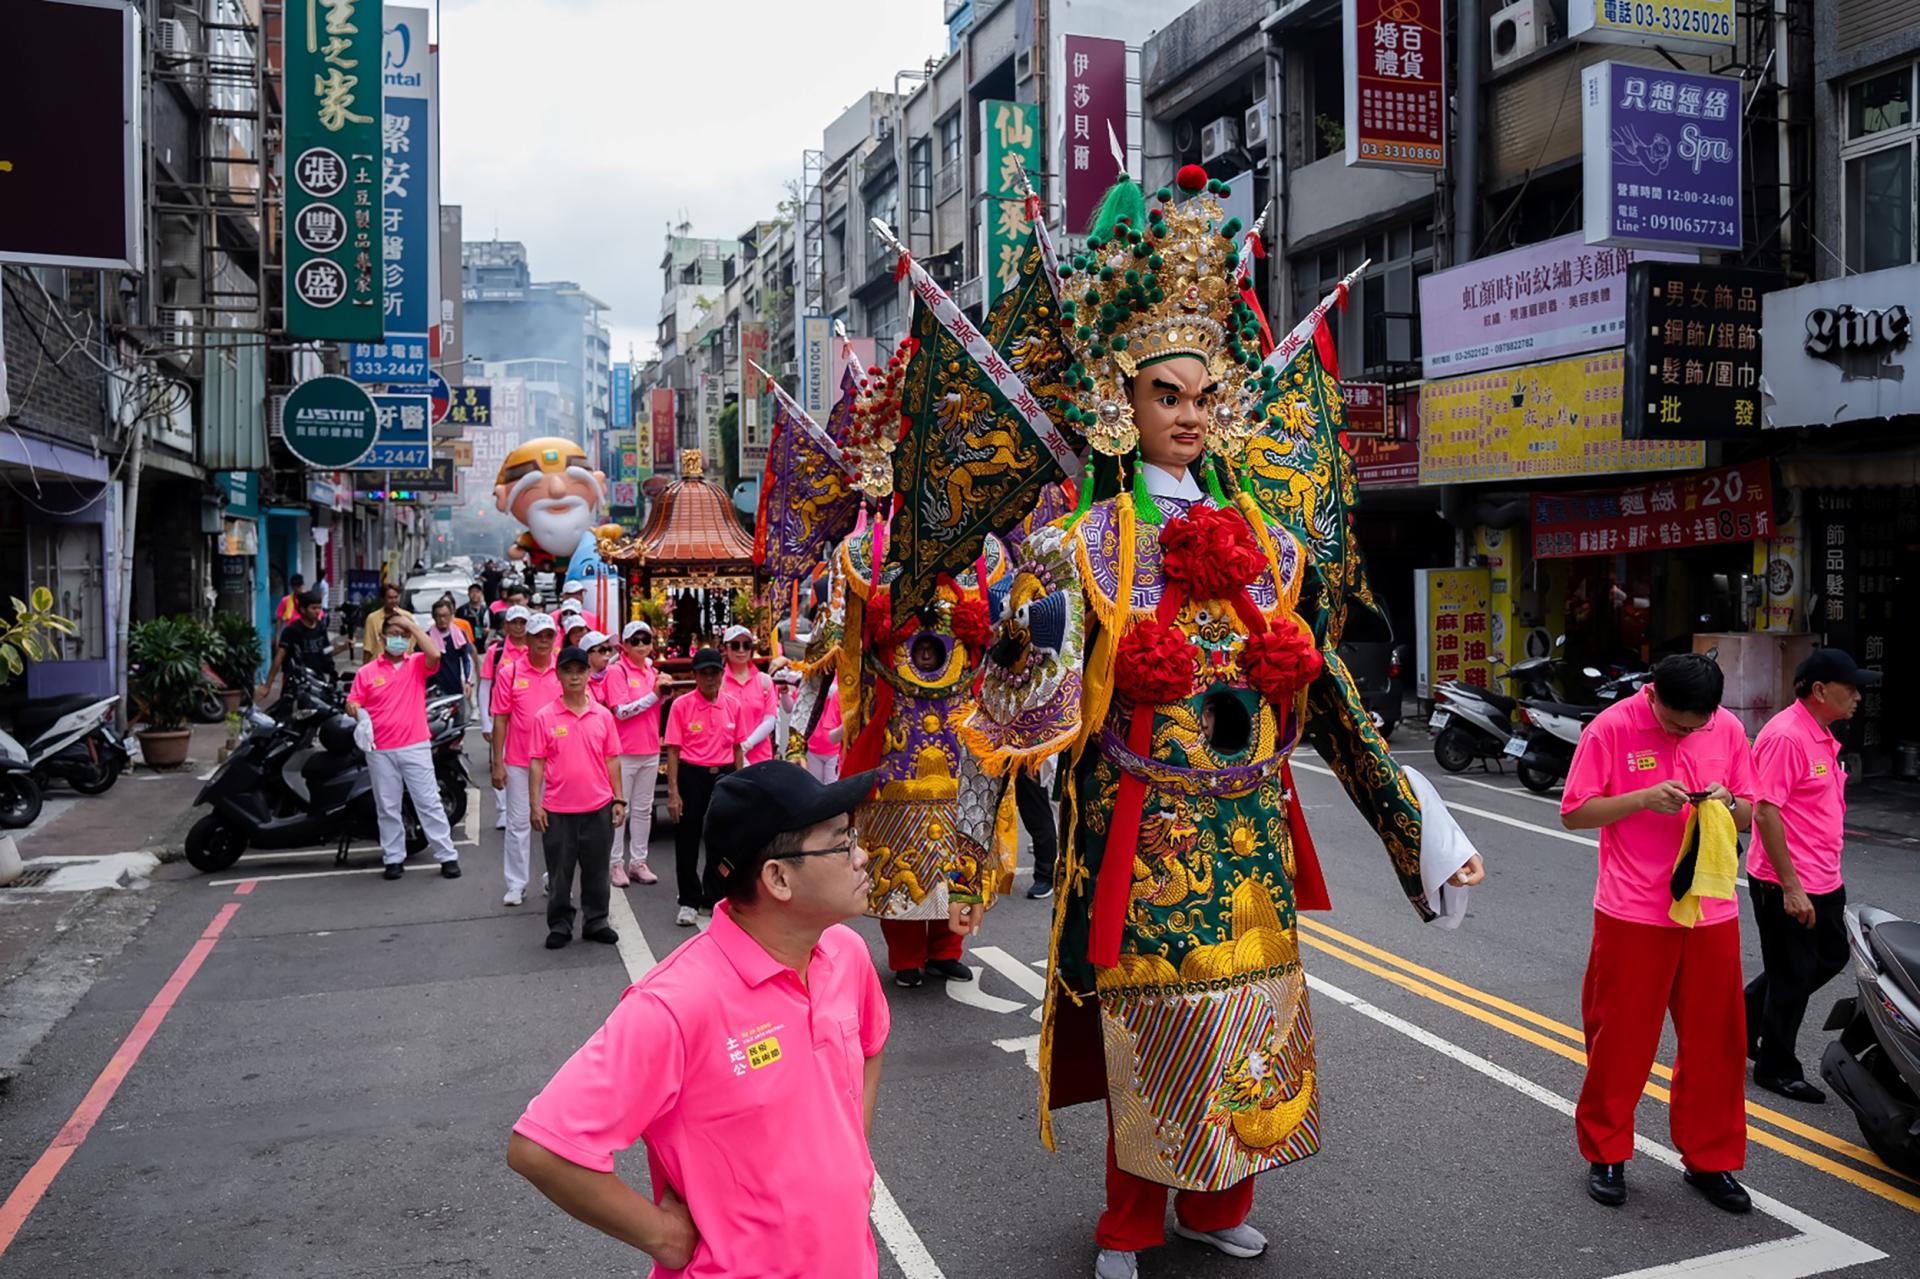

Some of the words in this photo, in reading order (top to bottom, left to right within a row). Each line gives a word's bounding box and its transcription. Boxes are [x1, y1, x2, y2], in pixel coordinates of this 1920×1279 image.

[1604, 0, 1632, 24] 電話
[1635, 3, 1729, 37] 03-3325026
[385, 73, 421, 87] ntal
[1073, 52, 1090, 171] 伊莎貝爾
[1622, 78, 1728, 120] 只想經絡
[1362, 143, 1441, 160] 03-3310860
[1679, 123, 1733, 175] Spa
[1617, 183, 1663, 200] 營業時間
[1666, 189, 1734, 207] 12:00-24:00
[1616, 219, 1640, 233] Line
[1618, 205, 1638, 218] 電話
[1666, 280, 1756, 312] 男女飾品
[1664, 318, 1756, 351] 鋼飾/銀飾
[1805, 304, 1911, 354] Line
[355, 361, 425, 377] 333-2447
[810, 340, 821, 411] BIRKENSTOCK
[1662, 356, 1756, 388] 髮飾/圍巾
[358, 449, 426, 464] 3-2447
